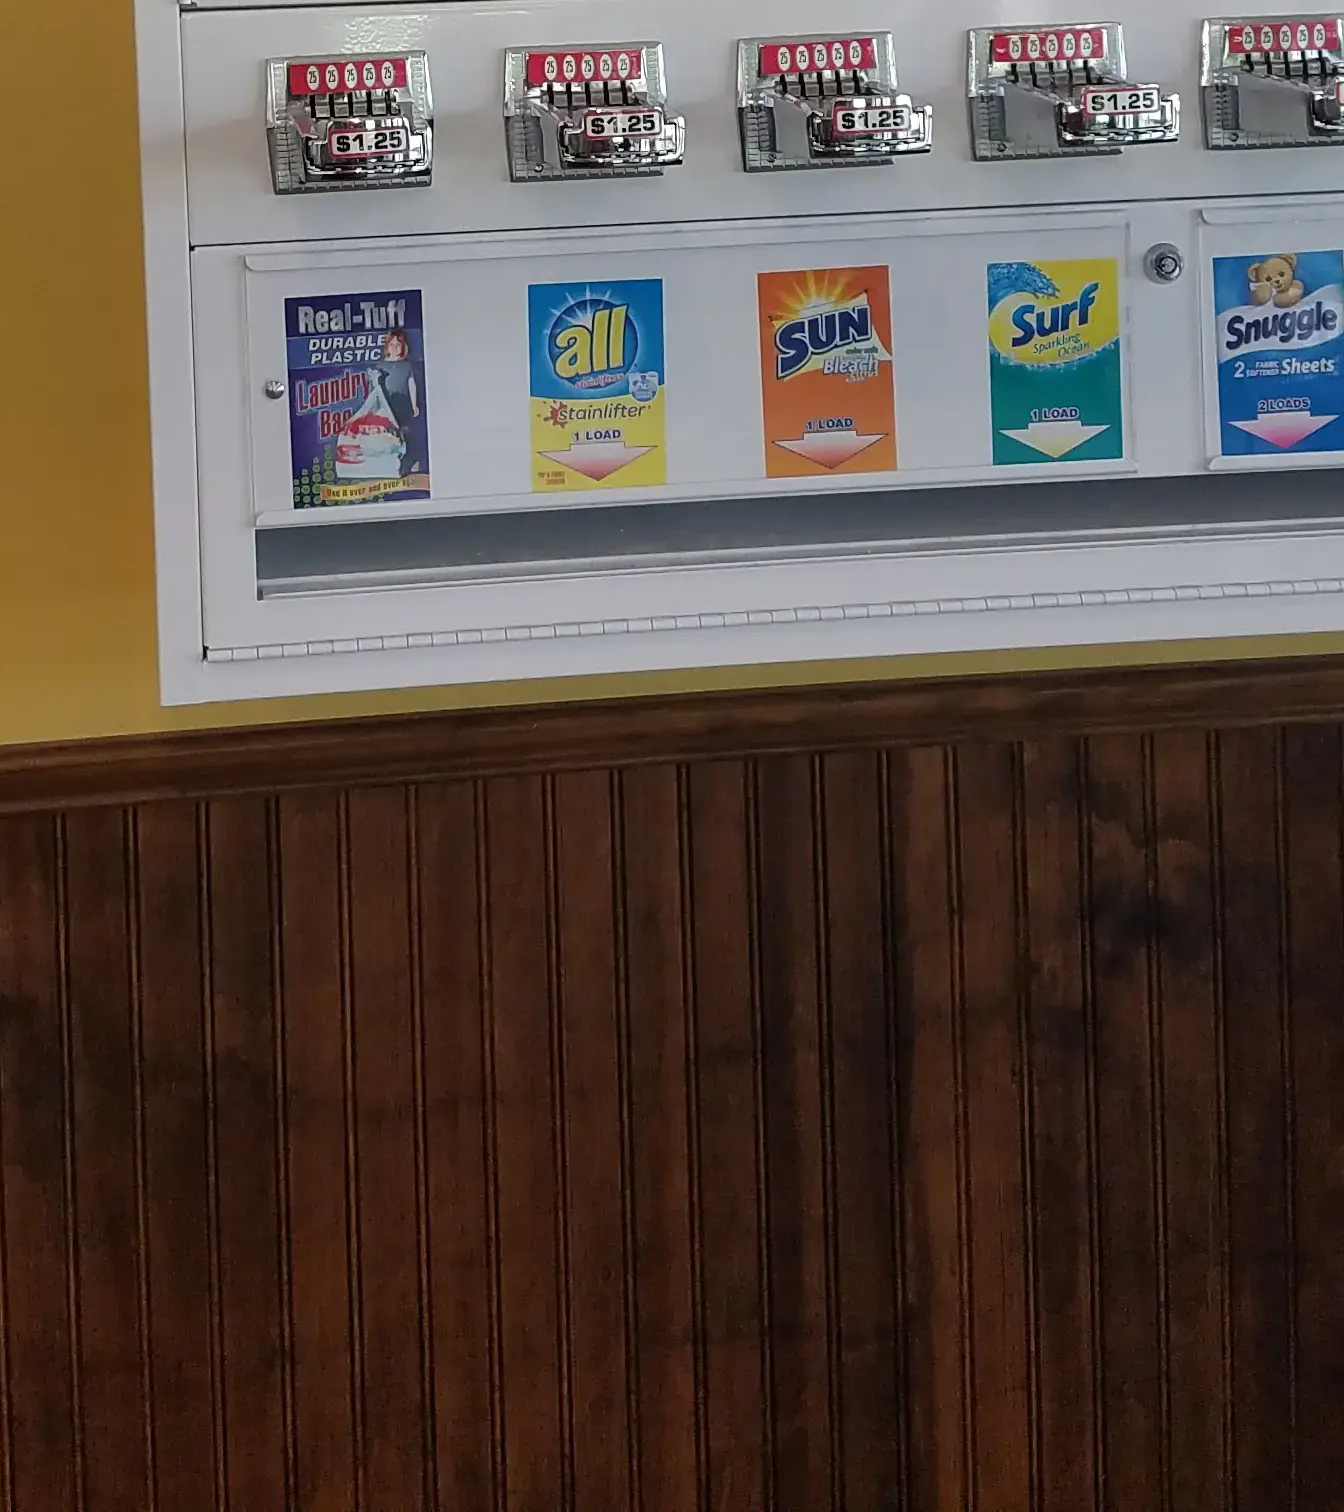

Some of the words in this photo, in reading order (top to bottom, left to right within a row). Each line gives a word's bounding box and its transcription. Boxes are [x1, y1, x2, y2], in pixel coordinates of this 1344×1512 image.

[1091, 92, 1155, 112] $1.25
[590, 114, 656, 135] $1.25
[841, 109, 905, 130] $1.25
[336, 131, 403, 153] $1.25
[297, 299, 406, 334] Real-Tuff
[1011, 282, 1100, 348] Surf
[1225, 301, 1338, 350] Snuggle
[308, 334, 387, 351] DURABLE
[555, 304, 629, 379] all
[775, 304, 873, 379] SUN
[1033, 333, 1081, 355] Sparkling
[1058, 342, 1090, 357] Ocean
[310, 349, 382, 365] PLASTIC
[823, 353, 880, 375] Bleach
[1281, 357, 1335, 375] Sheets
[1233, 361, 1245, 378] 2
[297, 371, 370, 413] Laundry
[559, 403, 648, 421] stainlifter
[1032, 410, 1038, 420] 1
[1043, 408, 1078, 419] LOAD
[1259, 401, 1266, 410] 2
[1269, 399, 1310, 409] LOADS
[806, 420, 813, 430] 1
[818, 417, 853, 429] LOAD
[574, 432, 580, 441] 1
[585, 429, 621, 440] LOAD
